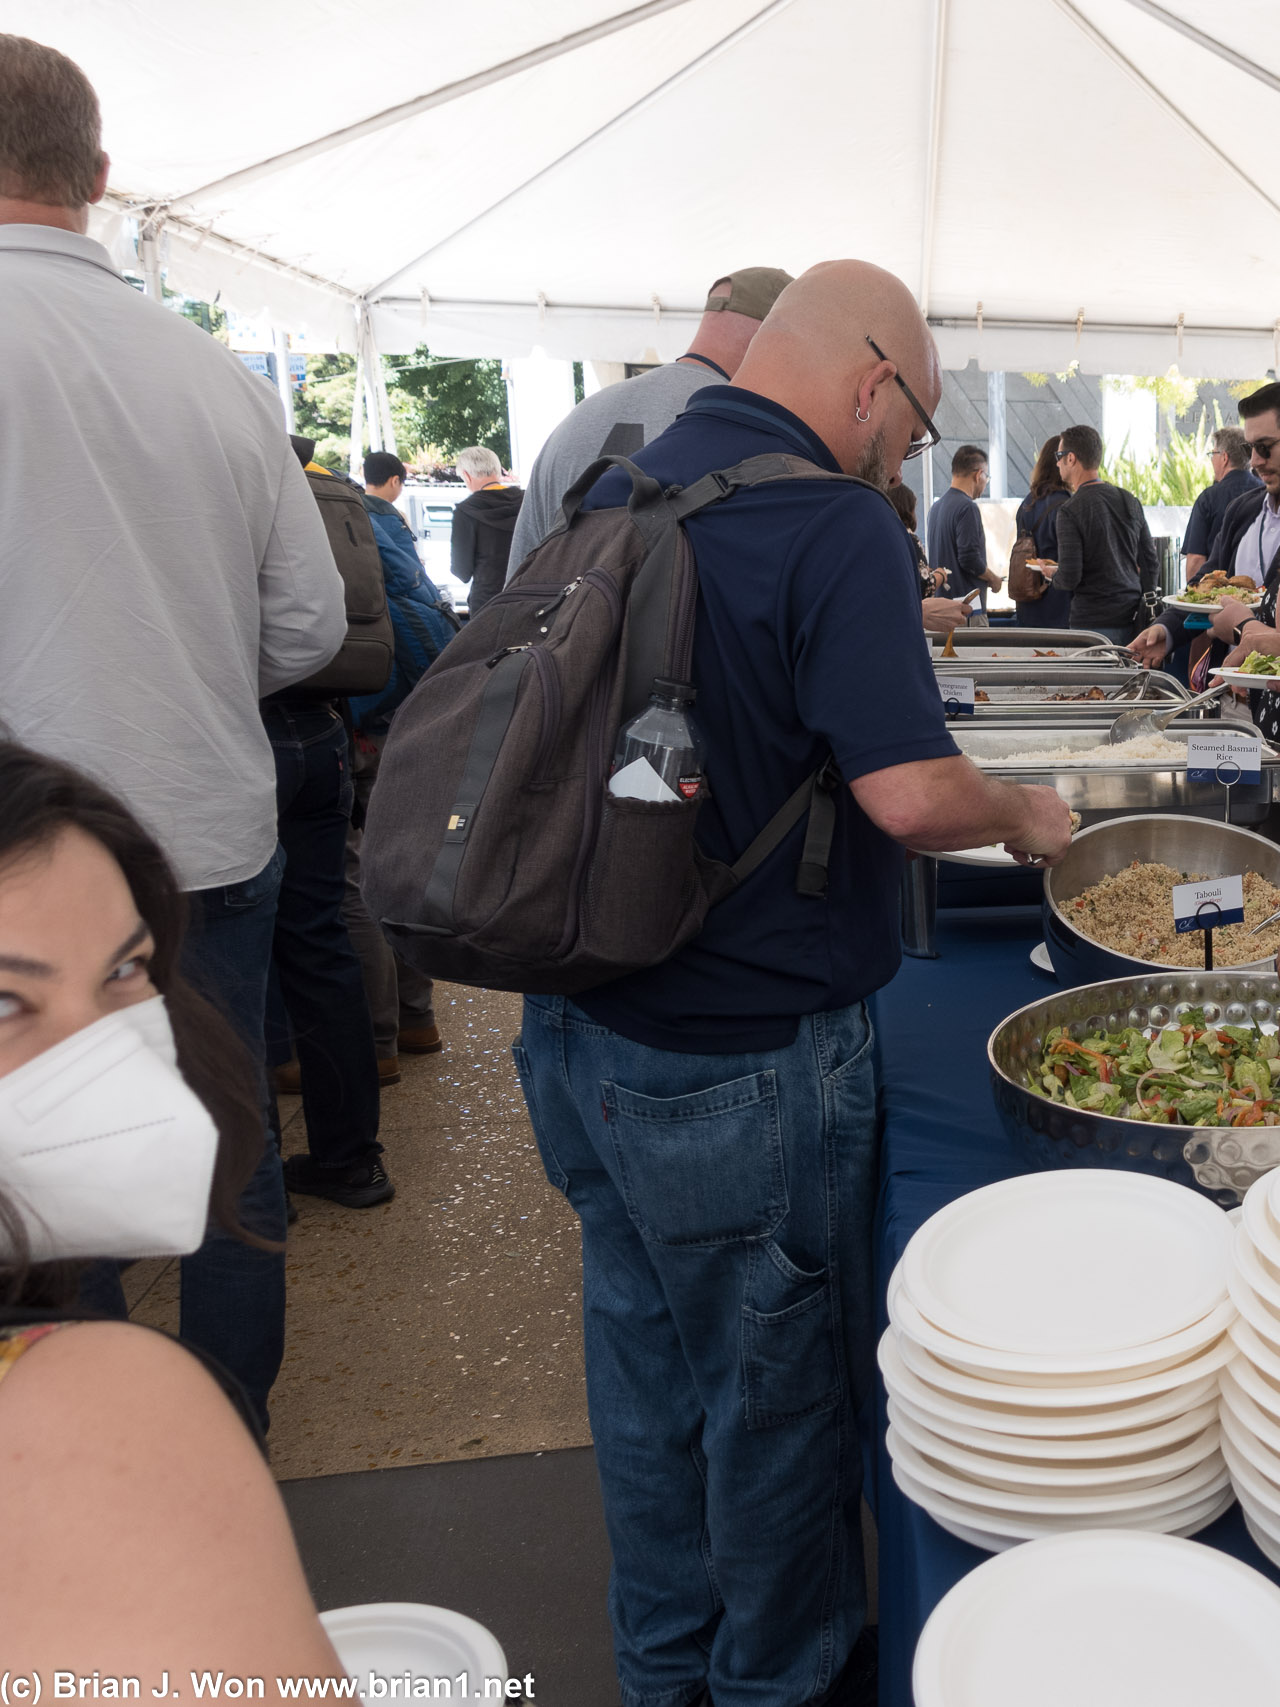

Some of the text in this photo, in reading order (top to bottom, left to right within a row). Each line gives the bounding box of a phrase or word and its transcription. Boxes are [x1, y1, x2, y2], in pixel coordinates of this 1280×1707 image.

[1191, 744, 1258, 753] Steamed Basmati
[1194, 888, 1222, 899] Tabouli
